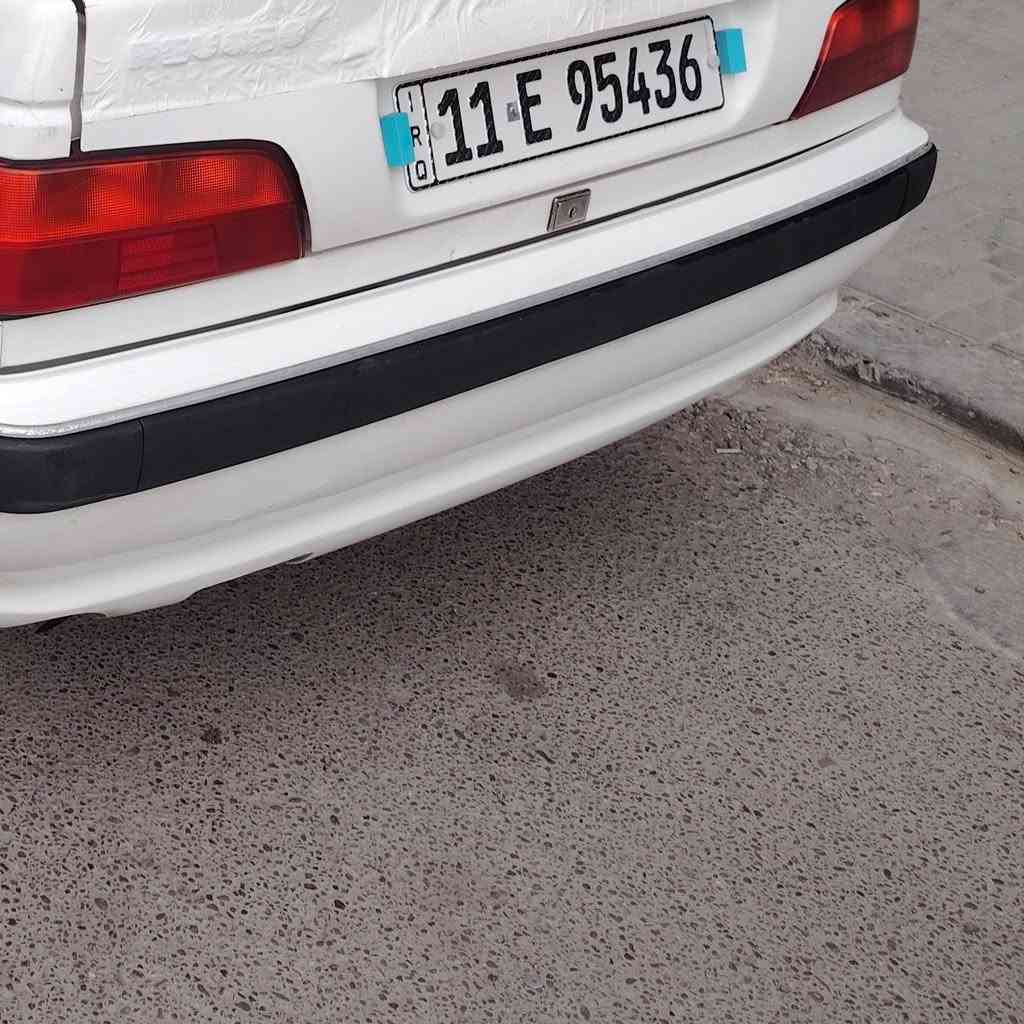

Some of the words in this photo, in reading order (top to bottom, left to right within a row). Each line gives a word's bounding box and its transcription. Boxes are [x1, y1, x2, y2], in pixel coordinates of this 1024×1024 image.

[407, 90, 428, 181] IRQ
[437, 81, 504, 166] 11
[515, 69, 553, 145] E
[566, 33, 703, 132] 95436
